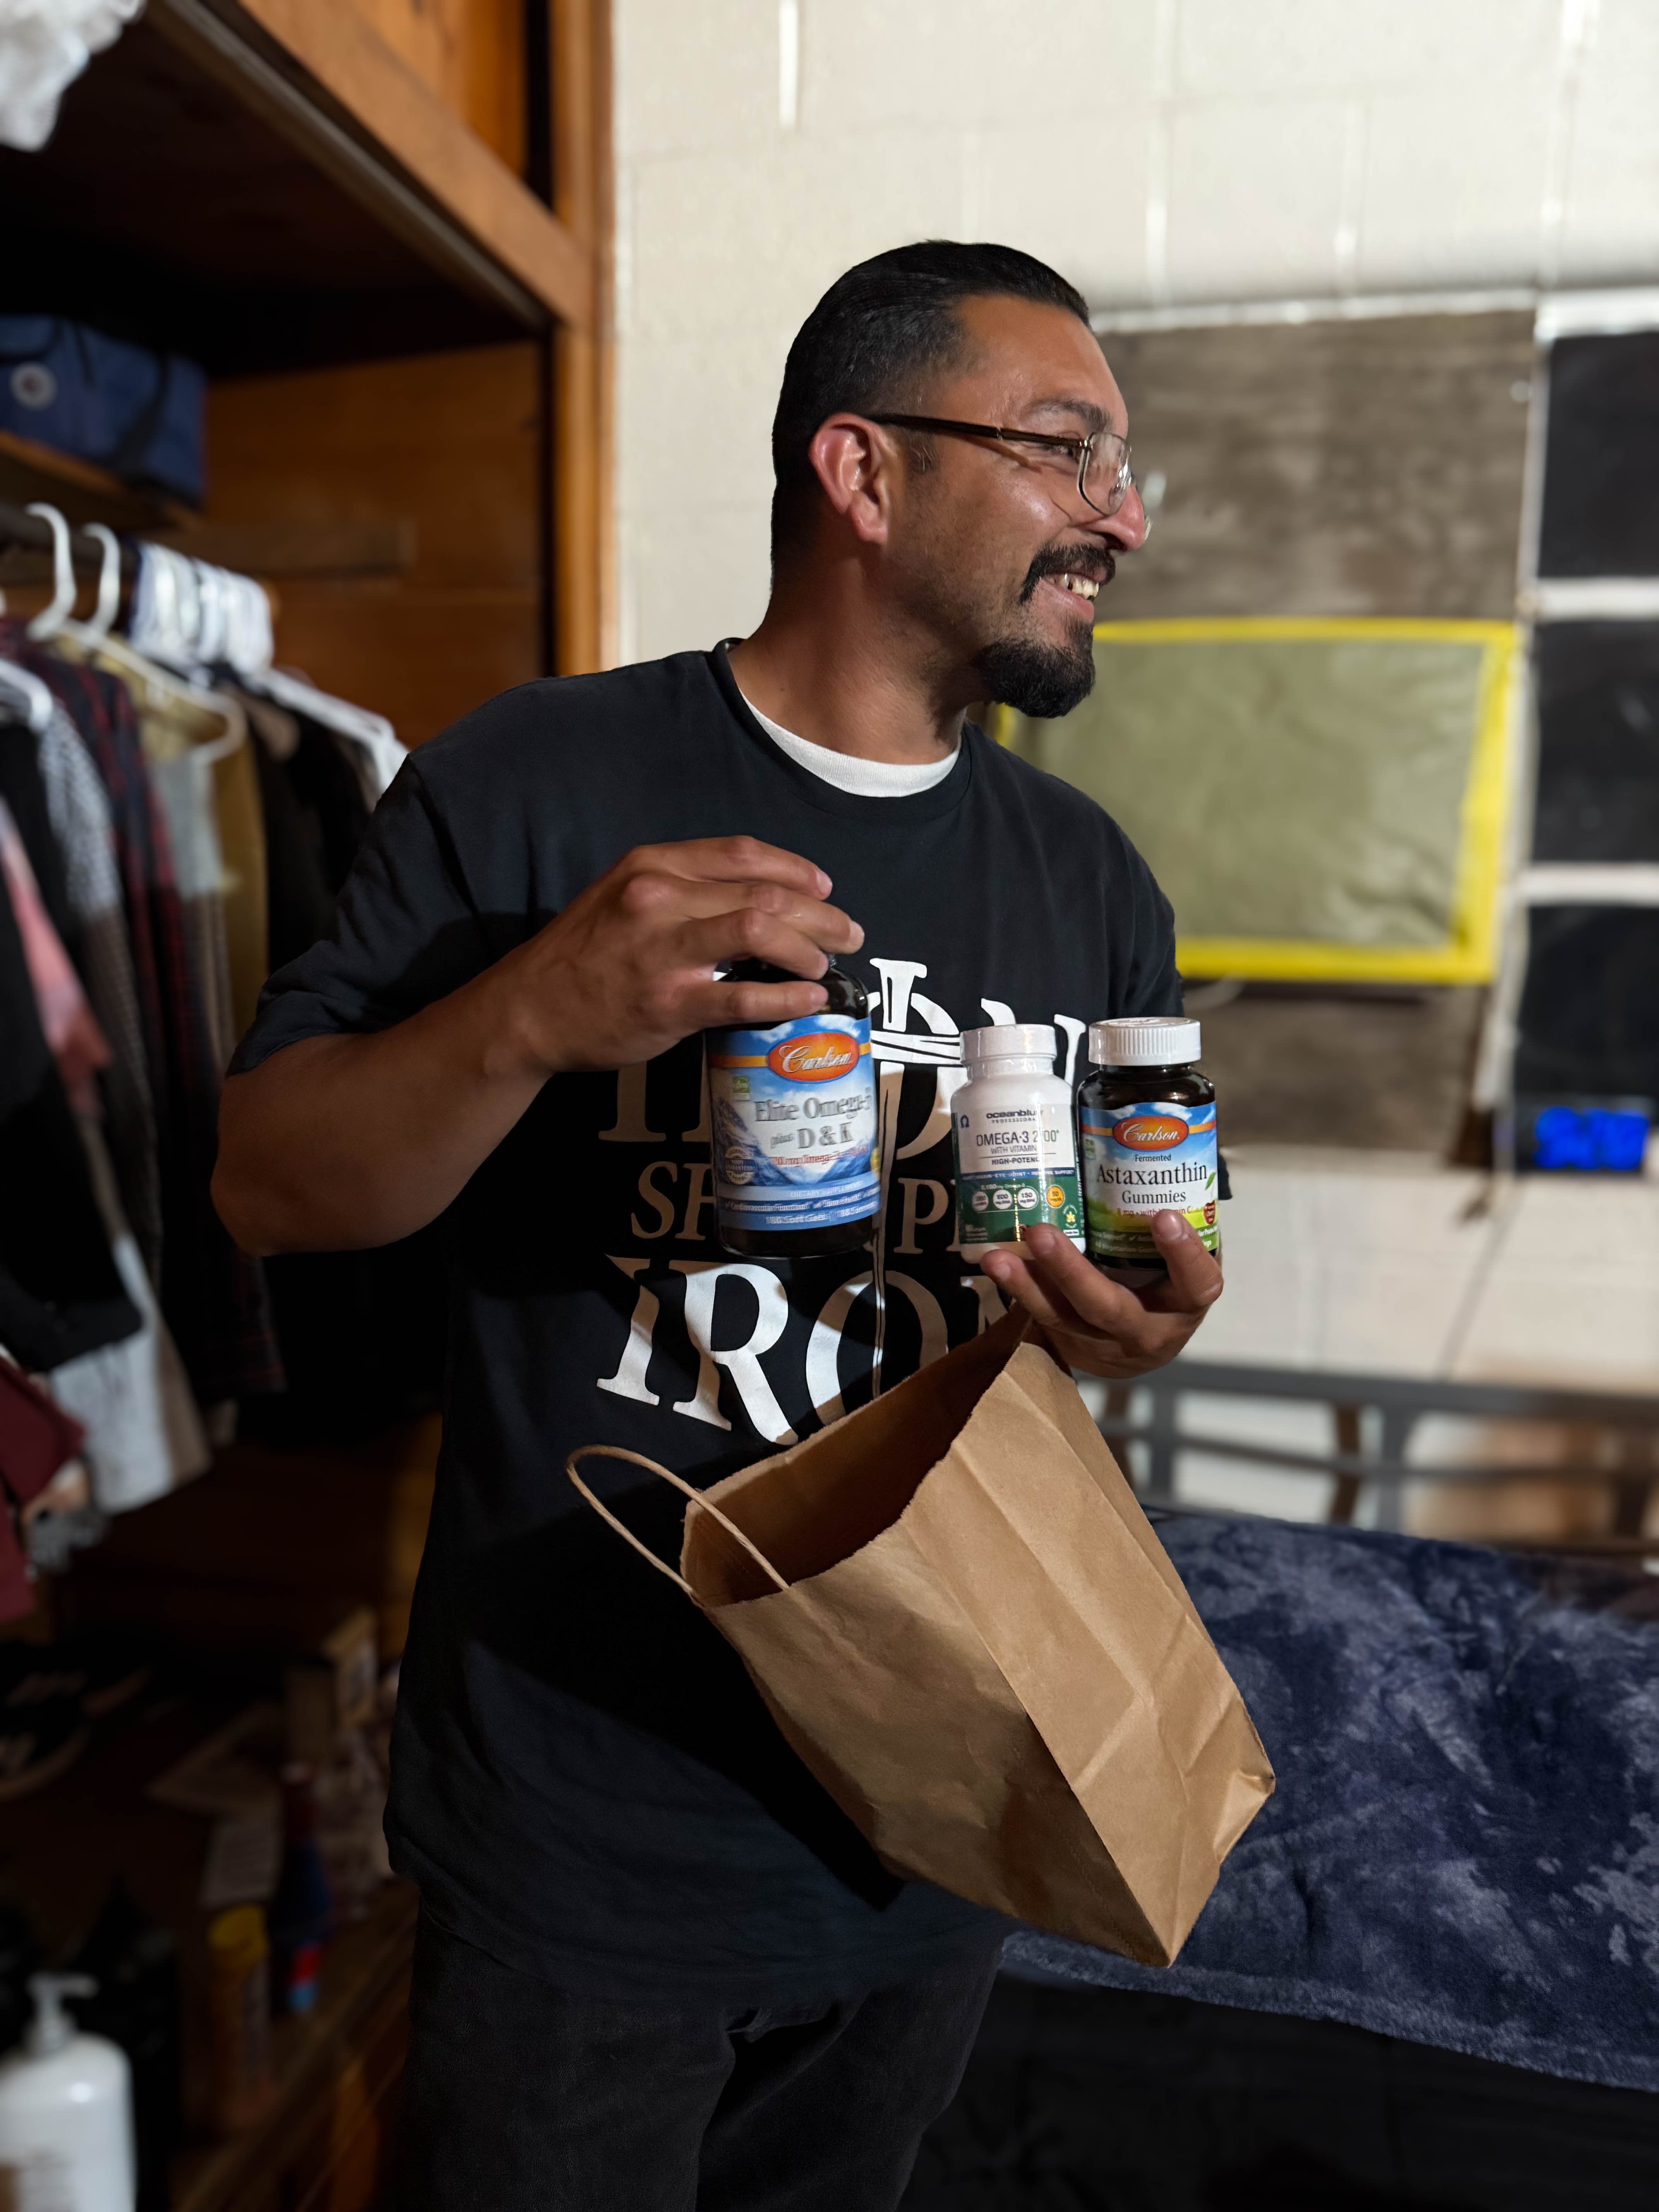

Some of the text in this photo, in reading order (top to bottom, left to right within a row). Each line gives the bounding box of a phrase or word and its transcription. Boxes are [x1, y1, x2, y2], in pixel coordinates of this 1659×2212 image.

[779, 1044, 854, 1073] Carlson
[986, 1109, 1043, 1119] oceanblu
[797, 1128, 816, 1149] D
[819, 1125, 836, 1146] &
[1121, 1122, 1180, 1142] Carlson
[991, 1156, 1041, 1165] HIGH-POTENC
[1135, 1154, 1171, 1162] Fermented
[1097, 1162, 1207, 1185] Astaxanthin
[1122, 1190, 1186, 1204] Gummies
